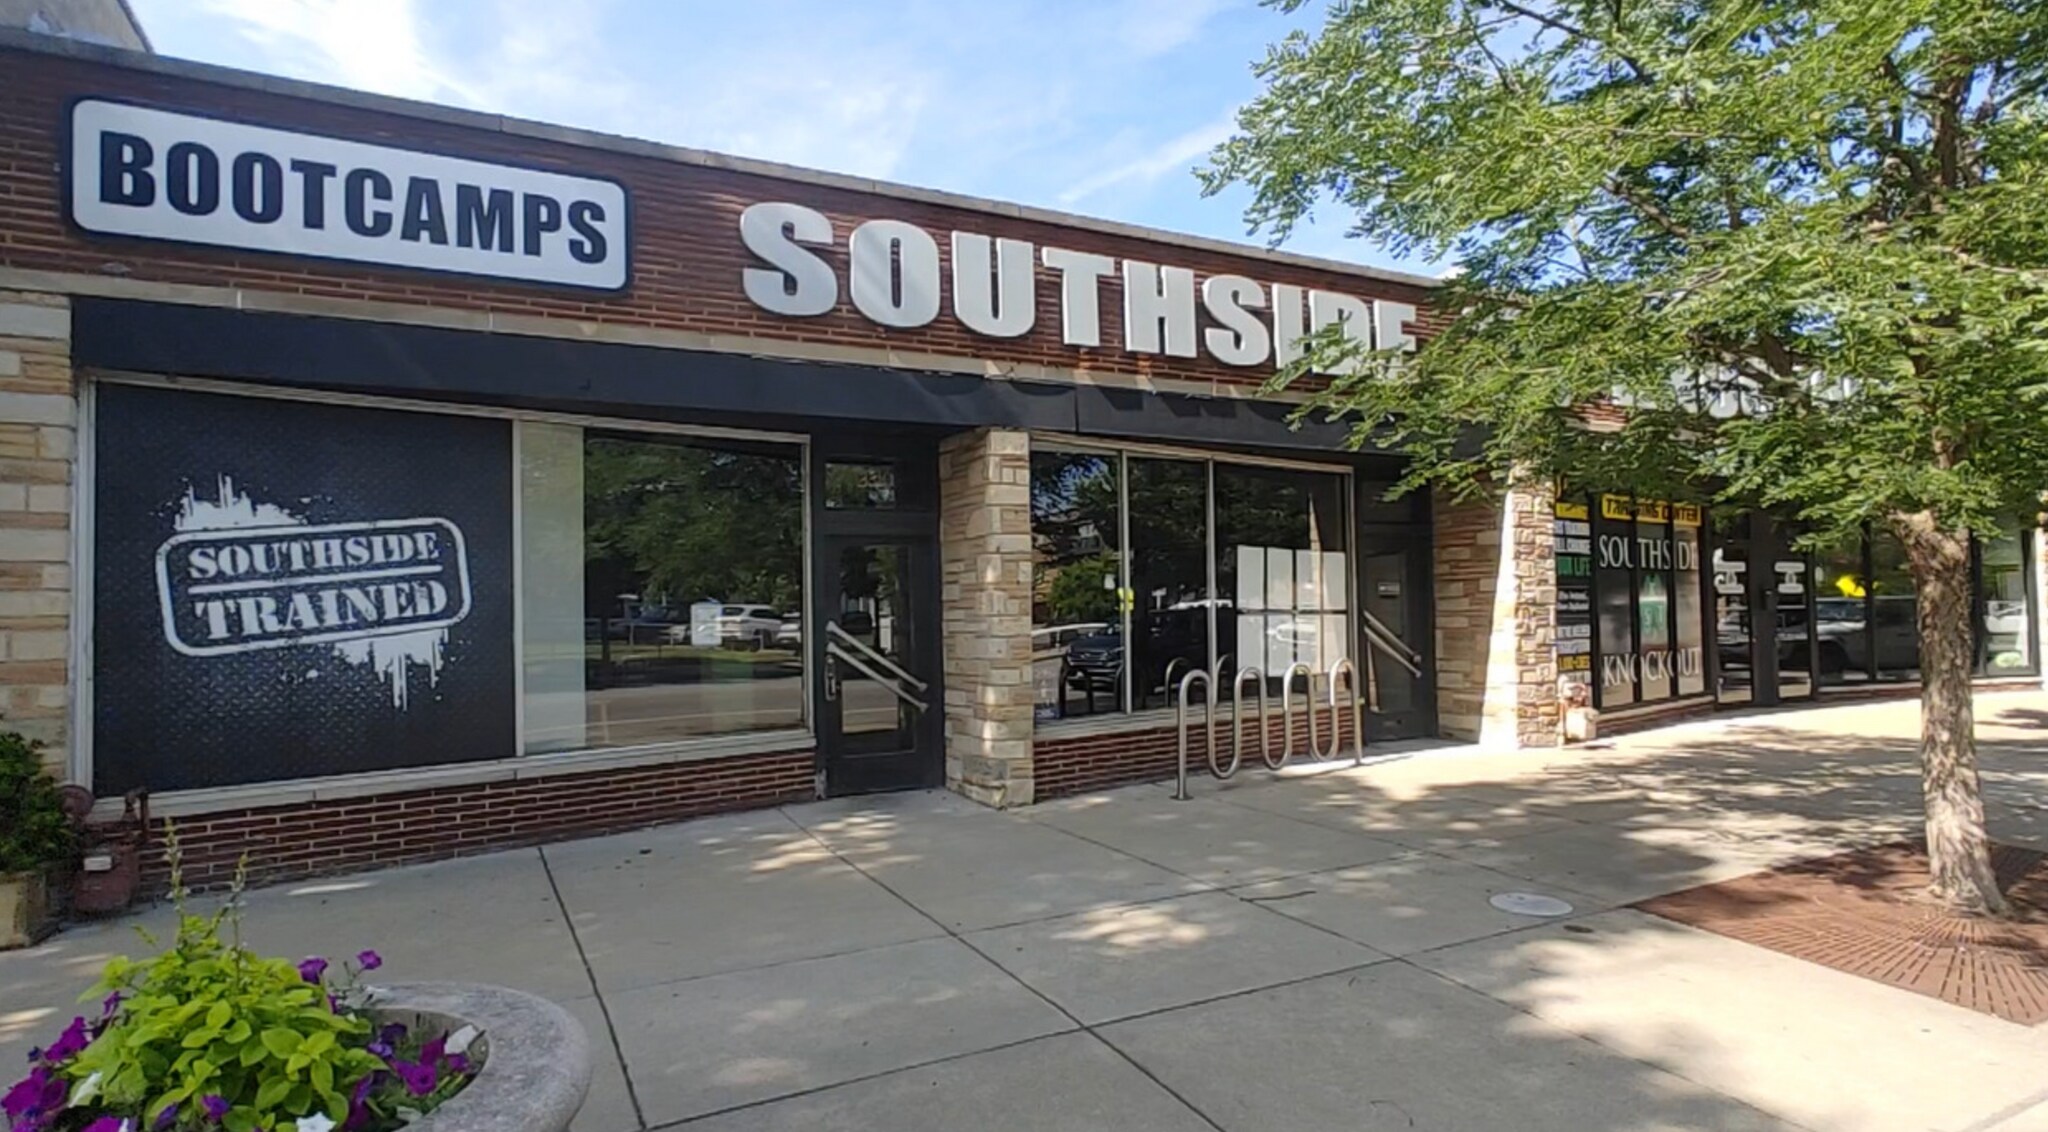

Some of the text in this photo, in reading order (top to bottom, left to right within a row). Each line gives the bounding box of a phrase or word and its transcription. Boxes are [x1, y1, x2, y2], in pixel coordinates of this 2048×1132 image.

[99, 130, 608, 264] BOOTCAMPS
[739, 202, 1417, 379] SOUTHSIDE
[1661, 505, 1699, 523] CNTER
[187, 531, 439, 579] SOUTHSIDE
[195, 580, 448, 641] TRAINED
[1602, 646, 1700, 688] KNOCKOUT
